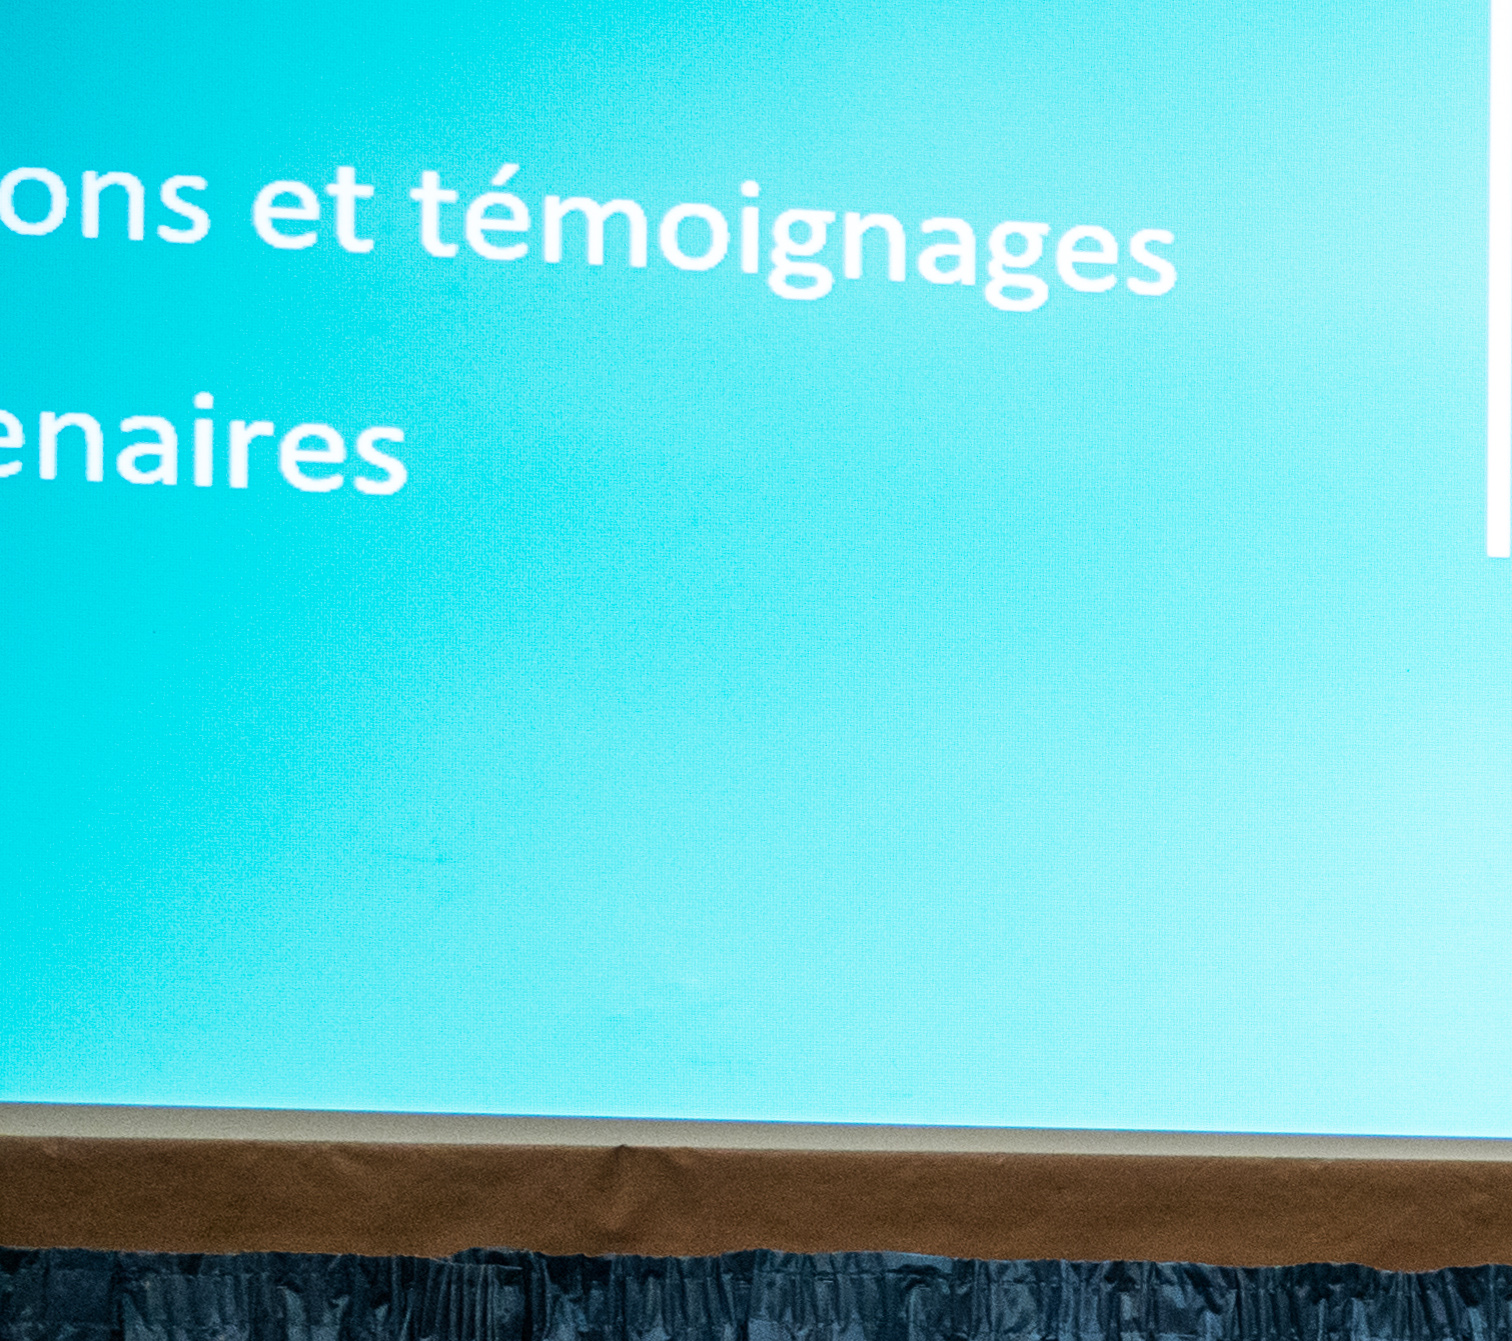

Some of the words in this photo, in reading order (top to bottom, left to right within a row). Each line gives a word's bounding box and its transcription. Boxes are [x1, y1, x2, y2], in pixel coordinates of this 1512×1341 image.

[0, 167, 210, 244] ons
[251, 165, 375, 254] et
[409, 163, 1178, 313] témoignages
[0, 391, 408, 496] enaires
